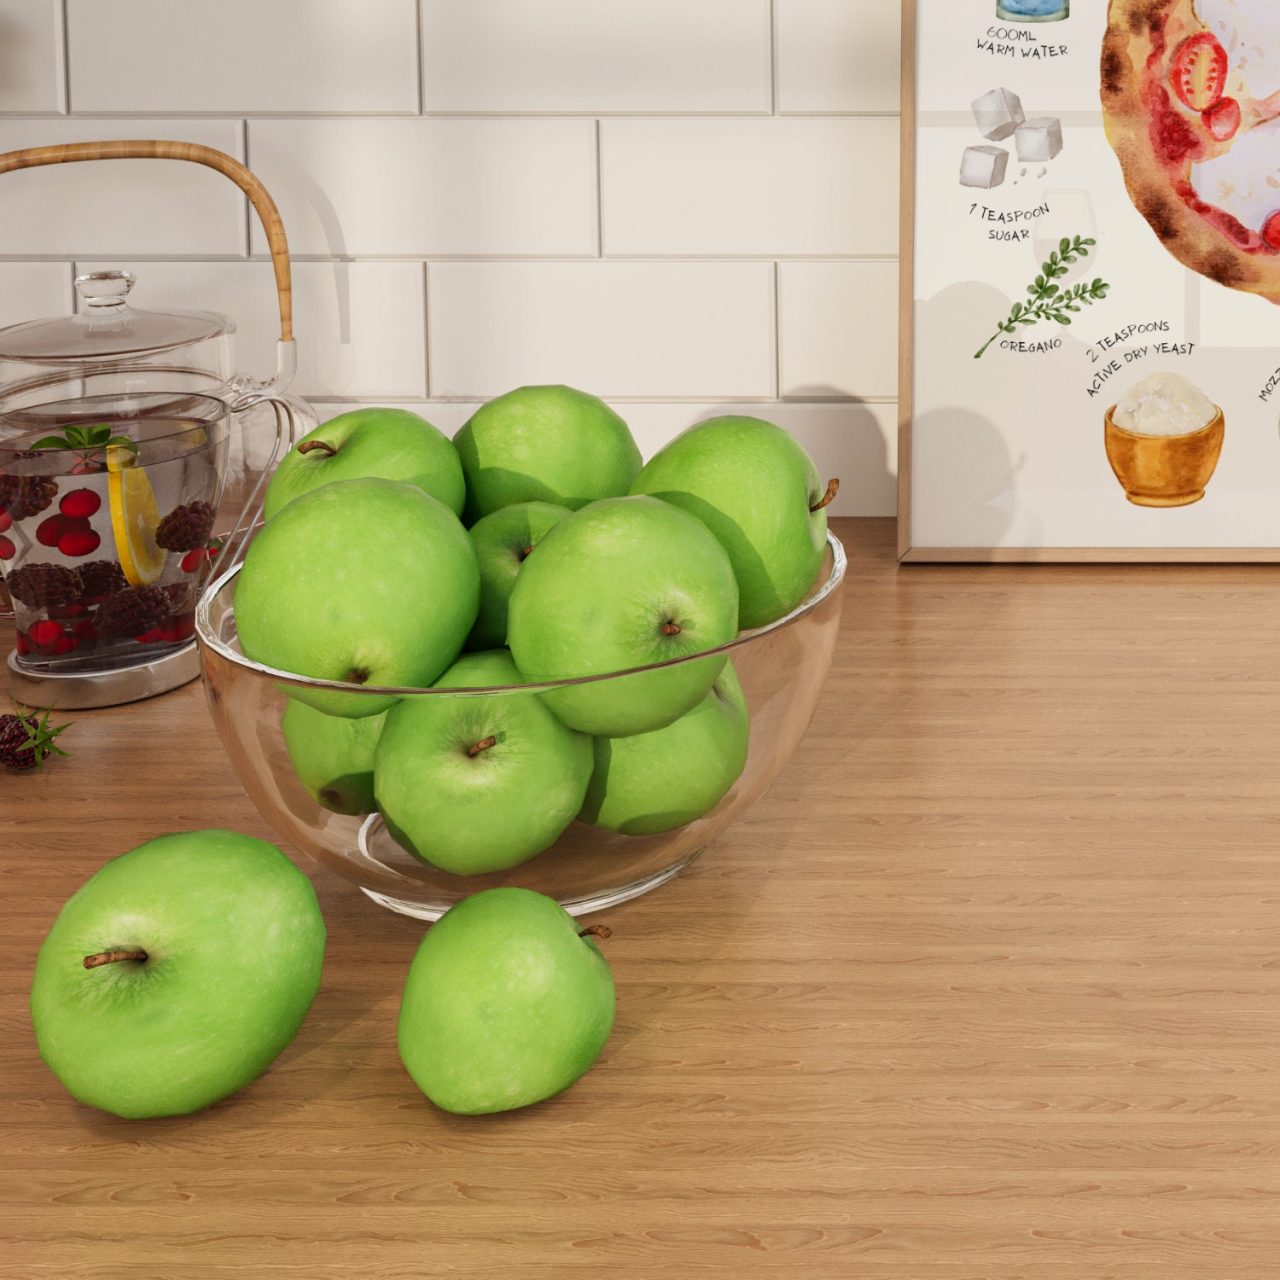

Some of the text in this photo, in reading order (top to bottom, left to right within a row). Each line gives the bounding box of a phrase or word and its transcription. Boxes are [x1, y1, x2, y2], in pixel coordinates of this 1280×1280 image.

[987, 26, 1037, 41] 600ML
[977, 38, 1067, 59] WARM WATER
[970, 203, 1049, 224] 1 TEASPOON
[989, 230, 1029, 242] SUGAR
[1000, 339, 1061, 352] OREGANO
[1086, 320, 1170, 362] 2 TEASPOONS
[1087, 343, 1194, 397] ACTIVE DRY YEAST
